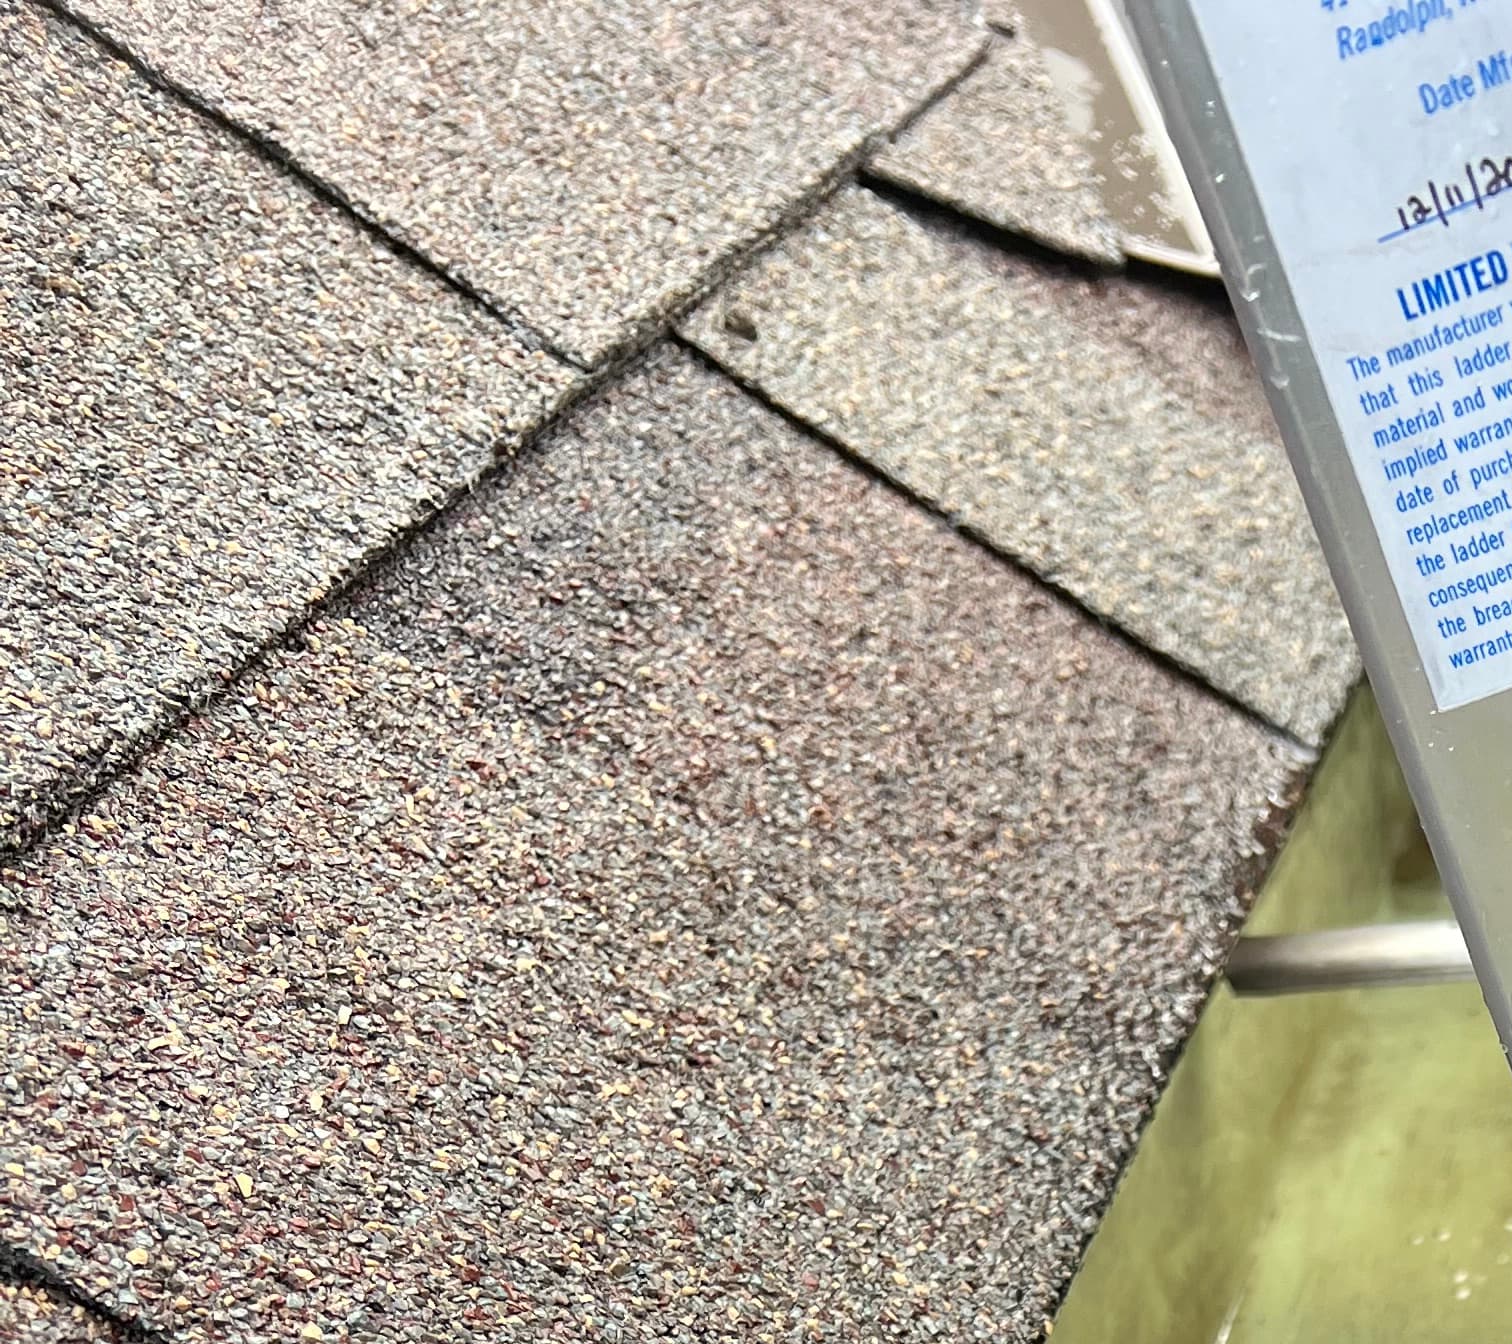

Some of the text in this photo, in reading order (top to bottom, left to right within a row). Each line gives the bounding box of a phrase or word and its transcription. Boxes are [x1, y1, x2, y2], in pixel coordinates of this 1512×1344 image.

[1418, 75, 1475, 114] Date
[1396, 249, 1508, 321] LIMITED
[1346, 356, 1380, 380] The
[1386, 305, 1502, 366] manufacturer
[1359, 383, 1398, 415] that
[1407, 368, 1443, 396] this
[1454, 341, 1510, 378] ladder
[1373, 401, 1444, 448] material
[1452, 386, 1485, 417] and
[1382, 438, 1447, 480] implied
[1396, 485, 1433, 512] date
[1442, 469, 1459, 494] of
[1406, 489, 1512, 545] replacement
[1416, 553, 1445, 576] the
[1450, 530, 1504, 563] ladder
[1437, 616, 1466, 638] the
